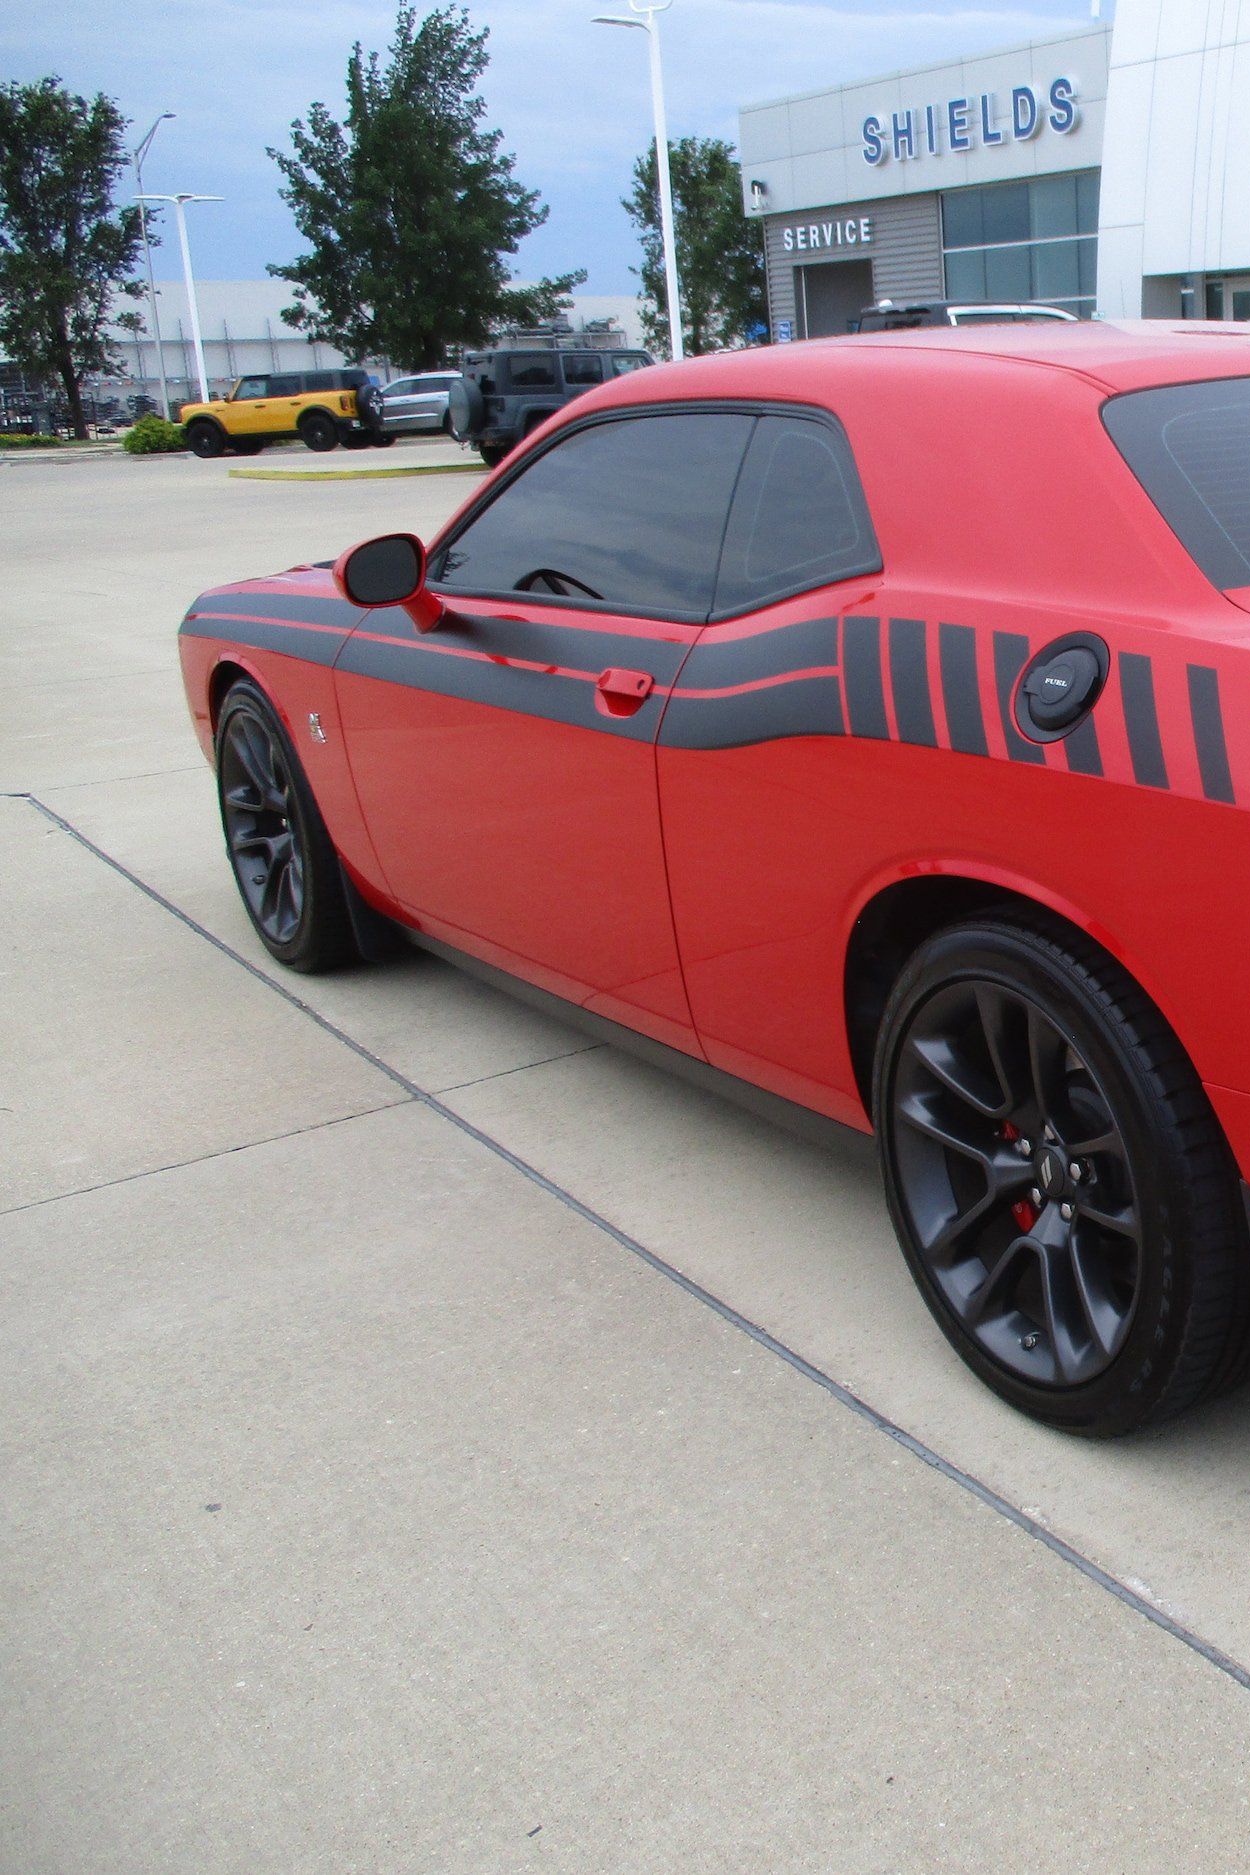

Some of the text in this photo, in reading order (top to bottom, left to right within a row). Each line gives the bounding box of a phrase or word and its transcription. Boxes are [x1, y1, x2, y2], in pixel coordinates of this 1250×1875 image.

[862, 77, 1077, 167] SHIELDS
[783, 218, 871, 251] SERVICE
[1044, 677, 1068, 687] FUEL
